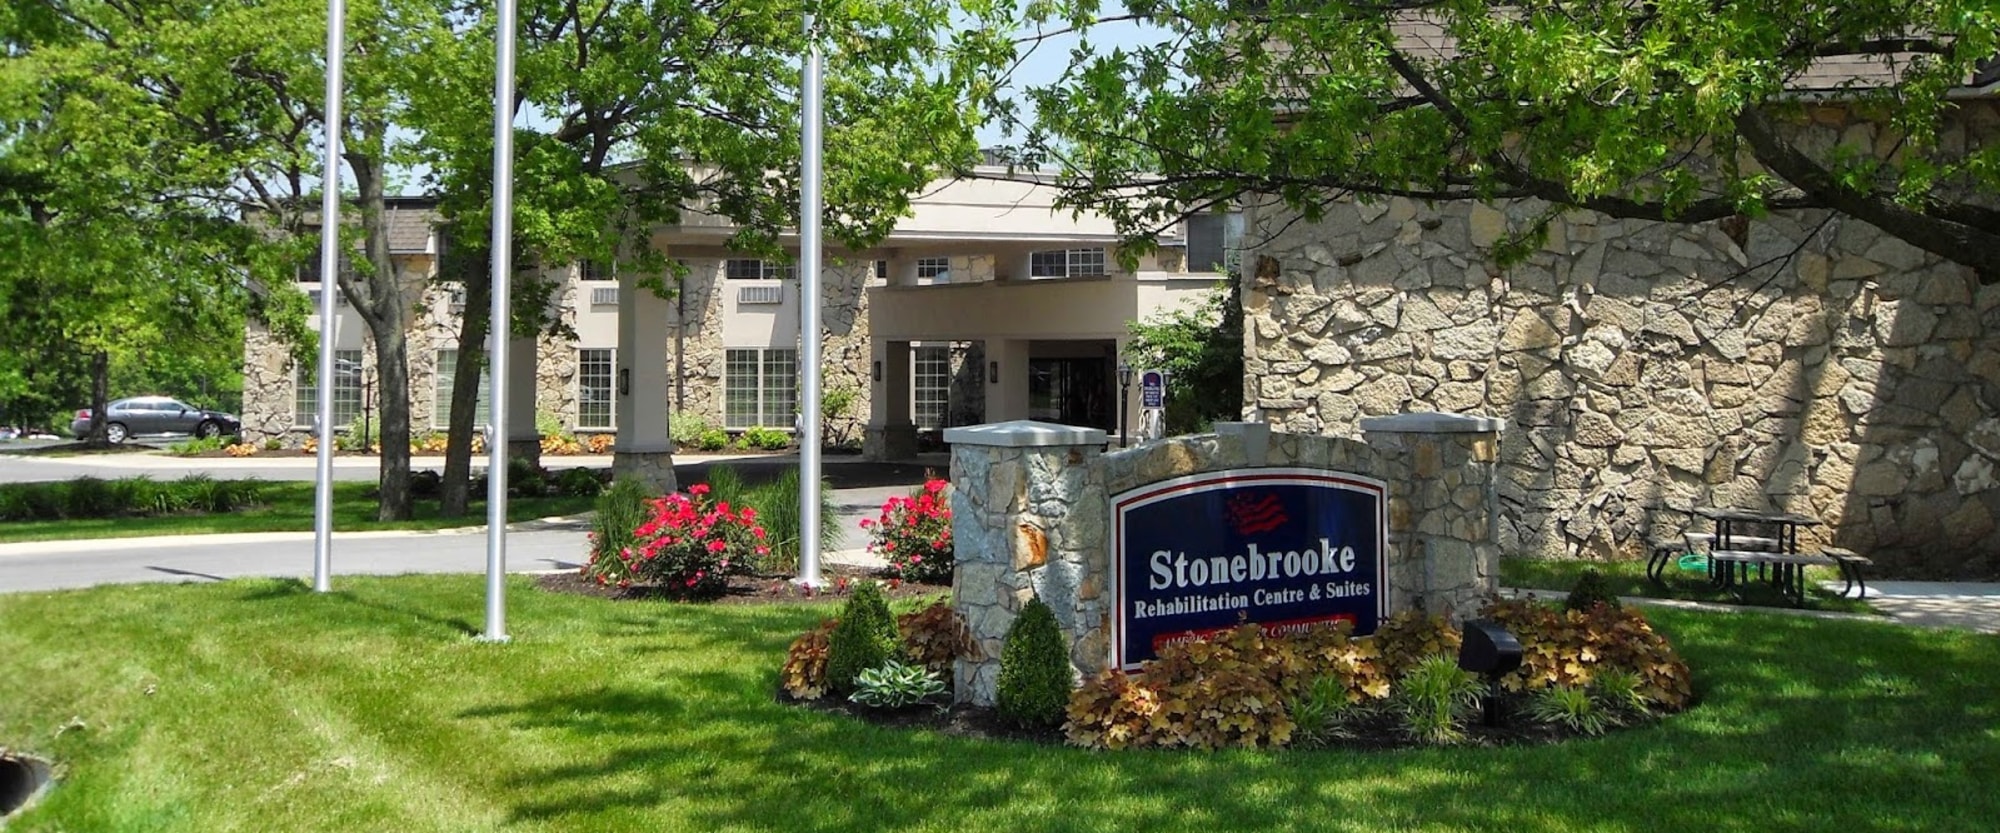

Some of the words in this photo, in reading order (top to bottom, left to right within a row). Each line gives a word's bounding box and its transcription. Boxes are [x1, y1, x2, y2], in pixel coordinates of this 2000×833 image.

[1150, 538, 1355, 590] Stonebrooke
[1134, 593, 1248, 618] Rehabilitation
[1254, 585, 1304, 606] Centre
[1309, 583, 1320, 600] &
[1326, 581, 1370, 599] Suites
